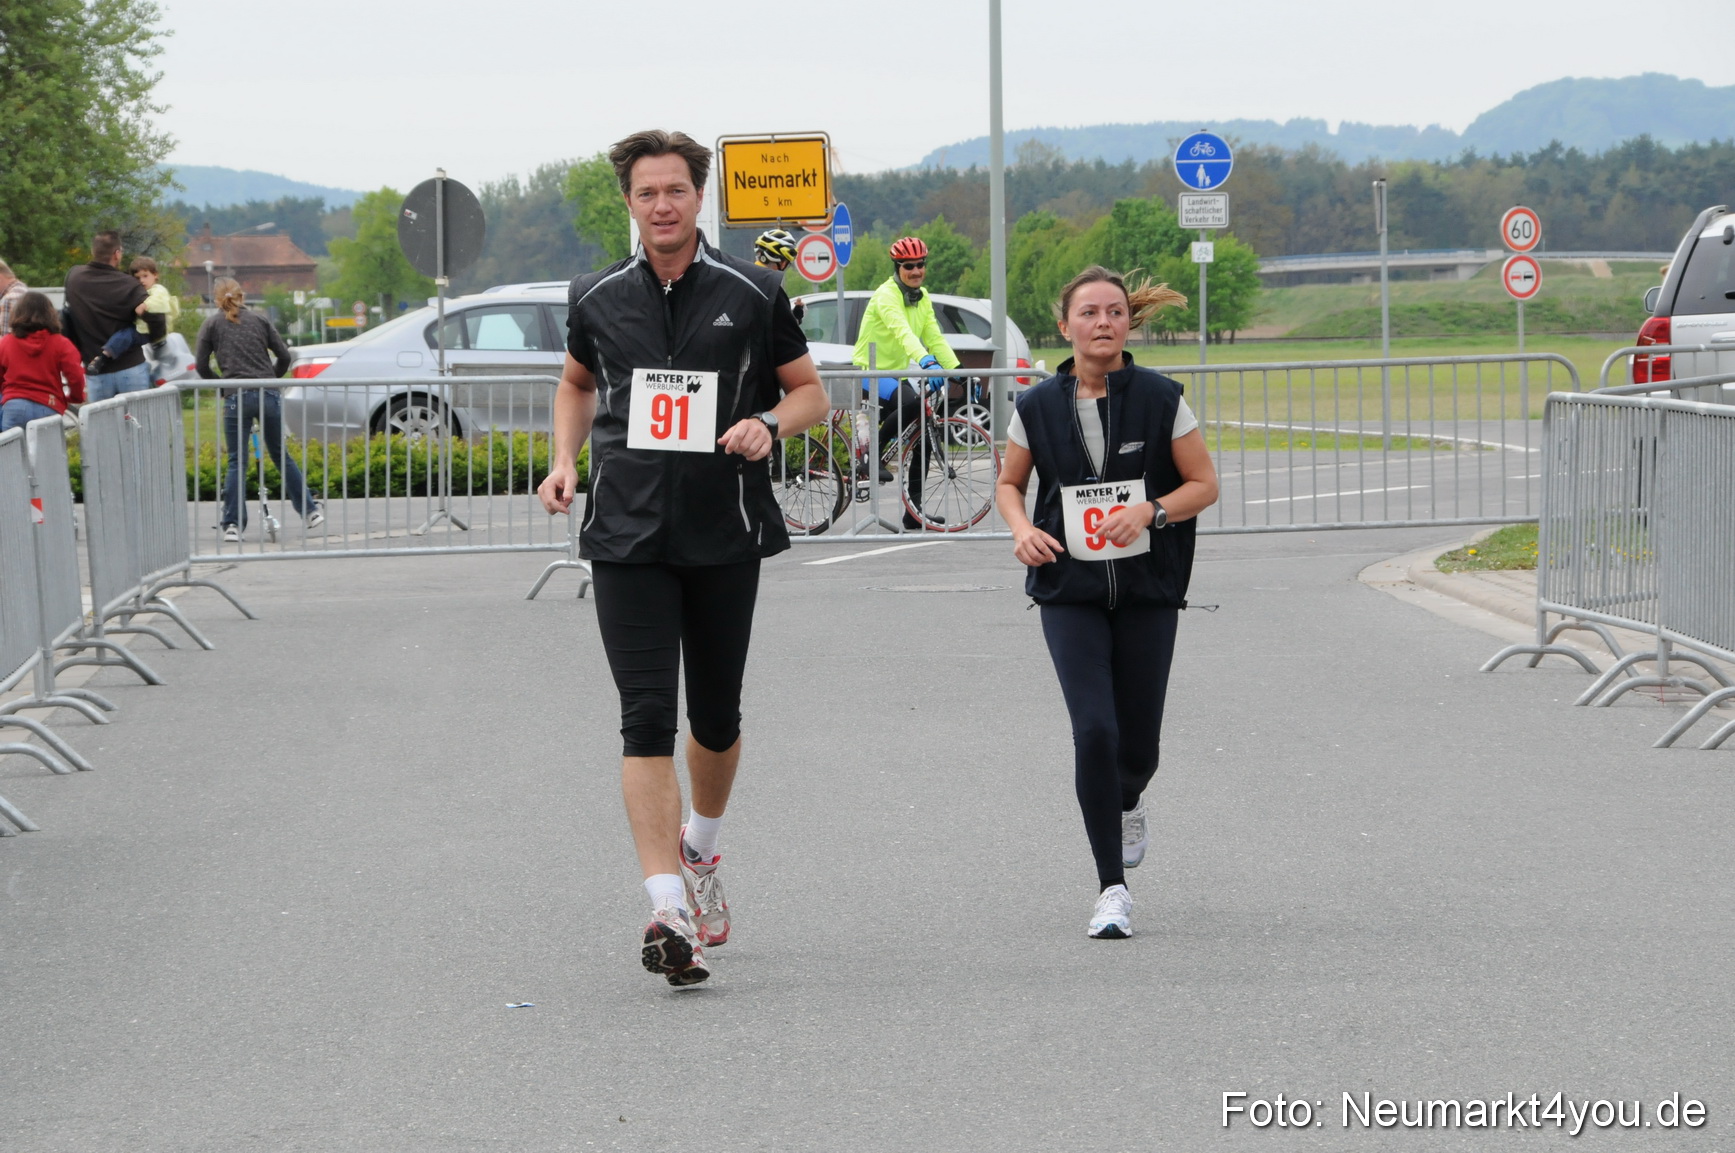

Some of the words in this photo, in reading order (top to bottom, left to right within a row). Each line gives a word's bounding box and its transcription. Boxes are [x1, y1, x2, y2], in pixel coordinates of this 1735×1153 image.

[761, 153, 790, 163] Nach
[734, 168, 818, 190] Neumarkt
[763, 196, 770, 207] 5
[778, 197, 793, 207] km
[1184, 207, 1223, 215] schaftlicher
[1184, 215, 1210, 224] Verkehr
[1211, 215, 1224, 223] frei
[1511, 220, 1532, 239] 60
[645, 373, 684, 384] MEYER
[645, 383, 685, 392] WERBUNG
[650, 393, 689, 441] 91
[1076, 487, 1113, 499] MEYER
[1076, 496, 1115, 505] WERBUNG
